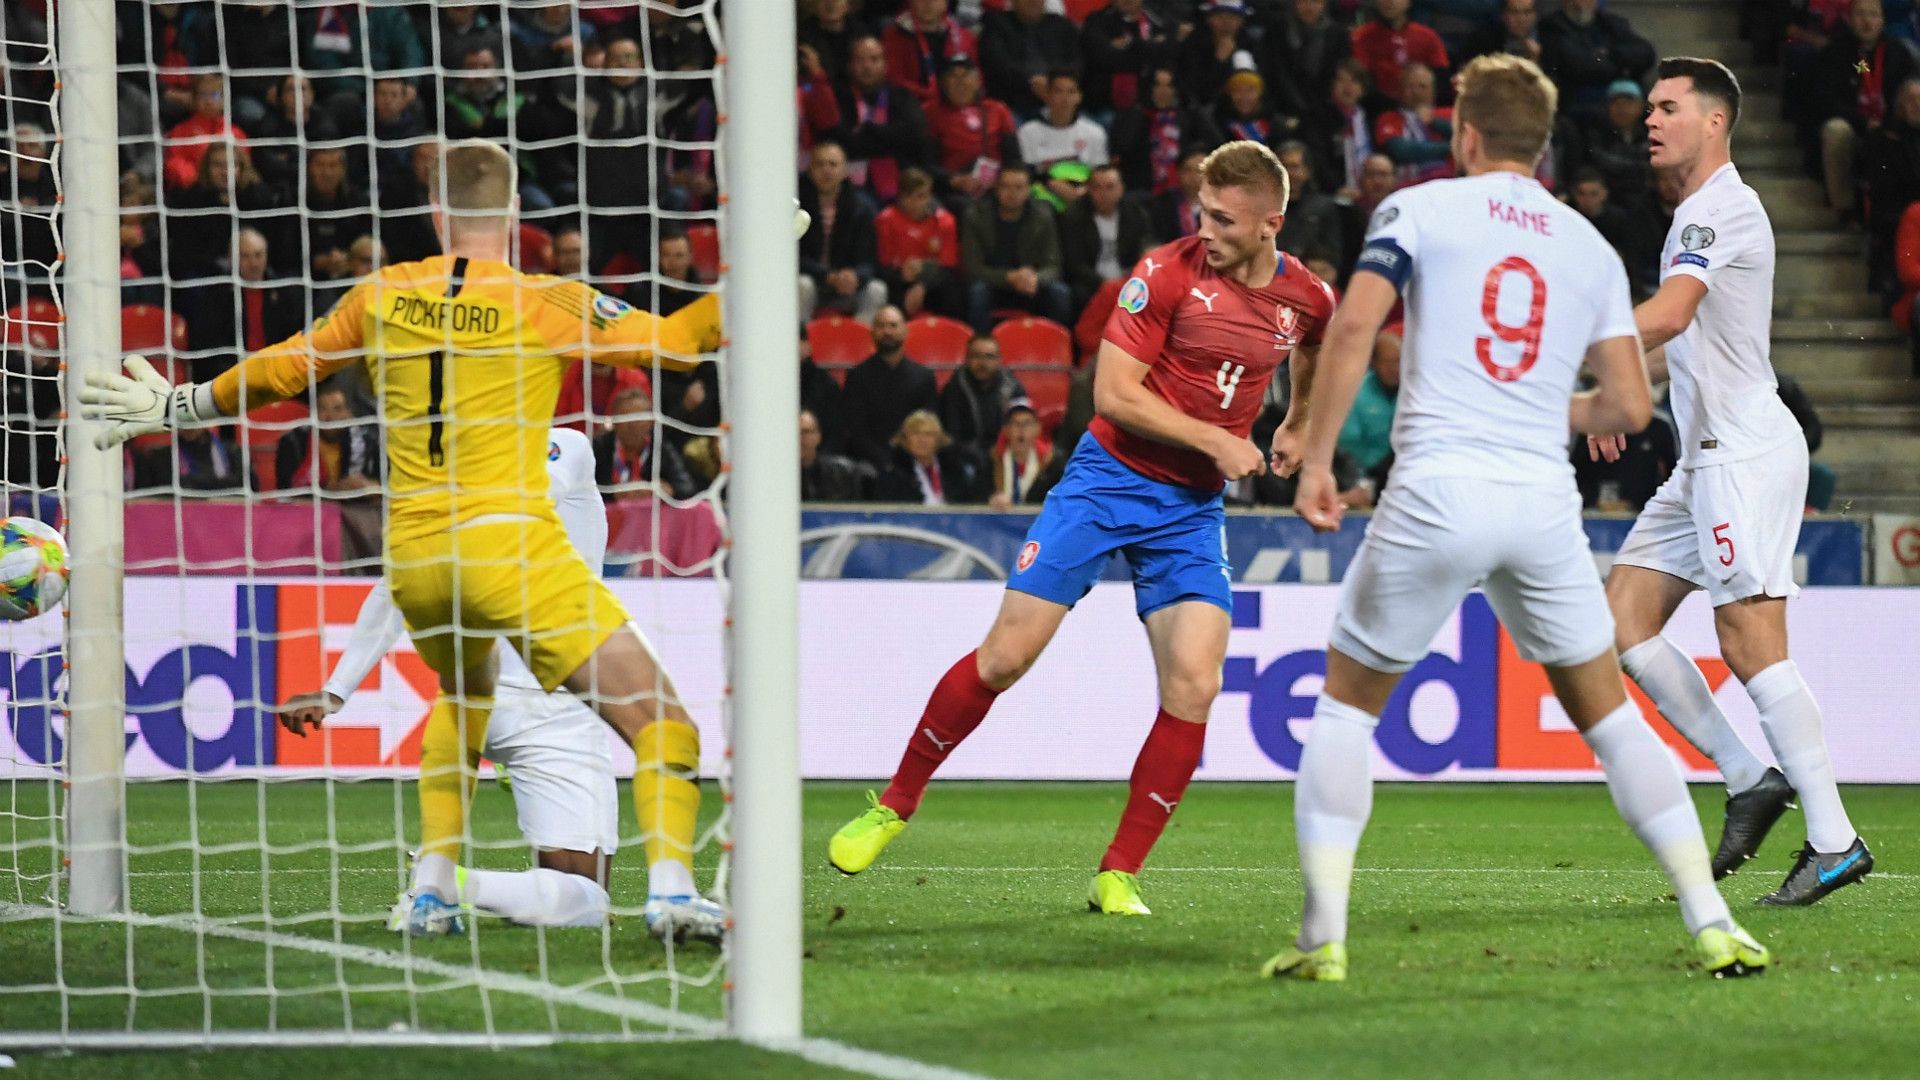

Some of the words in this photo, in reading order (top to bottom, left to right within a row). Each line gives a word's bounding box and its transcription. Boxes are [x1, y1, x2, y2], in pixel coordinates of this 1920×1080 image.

[1488, 198, 1553, 237] KANE
[389, 296, 499, 334] PICKFORD
[1475, 255, 1547, 383] 9
[1216, 360, 1246, 410] 4
[428, 351, 445, 467] 1
[1712, 522, 1735, 567] 5
